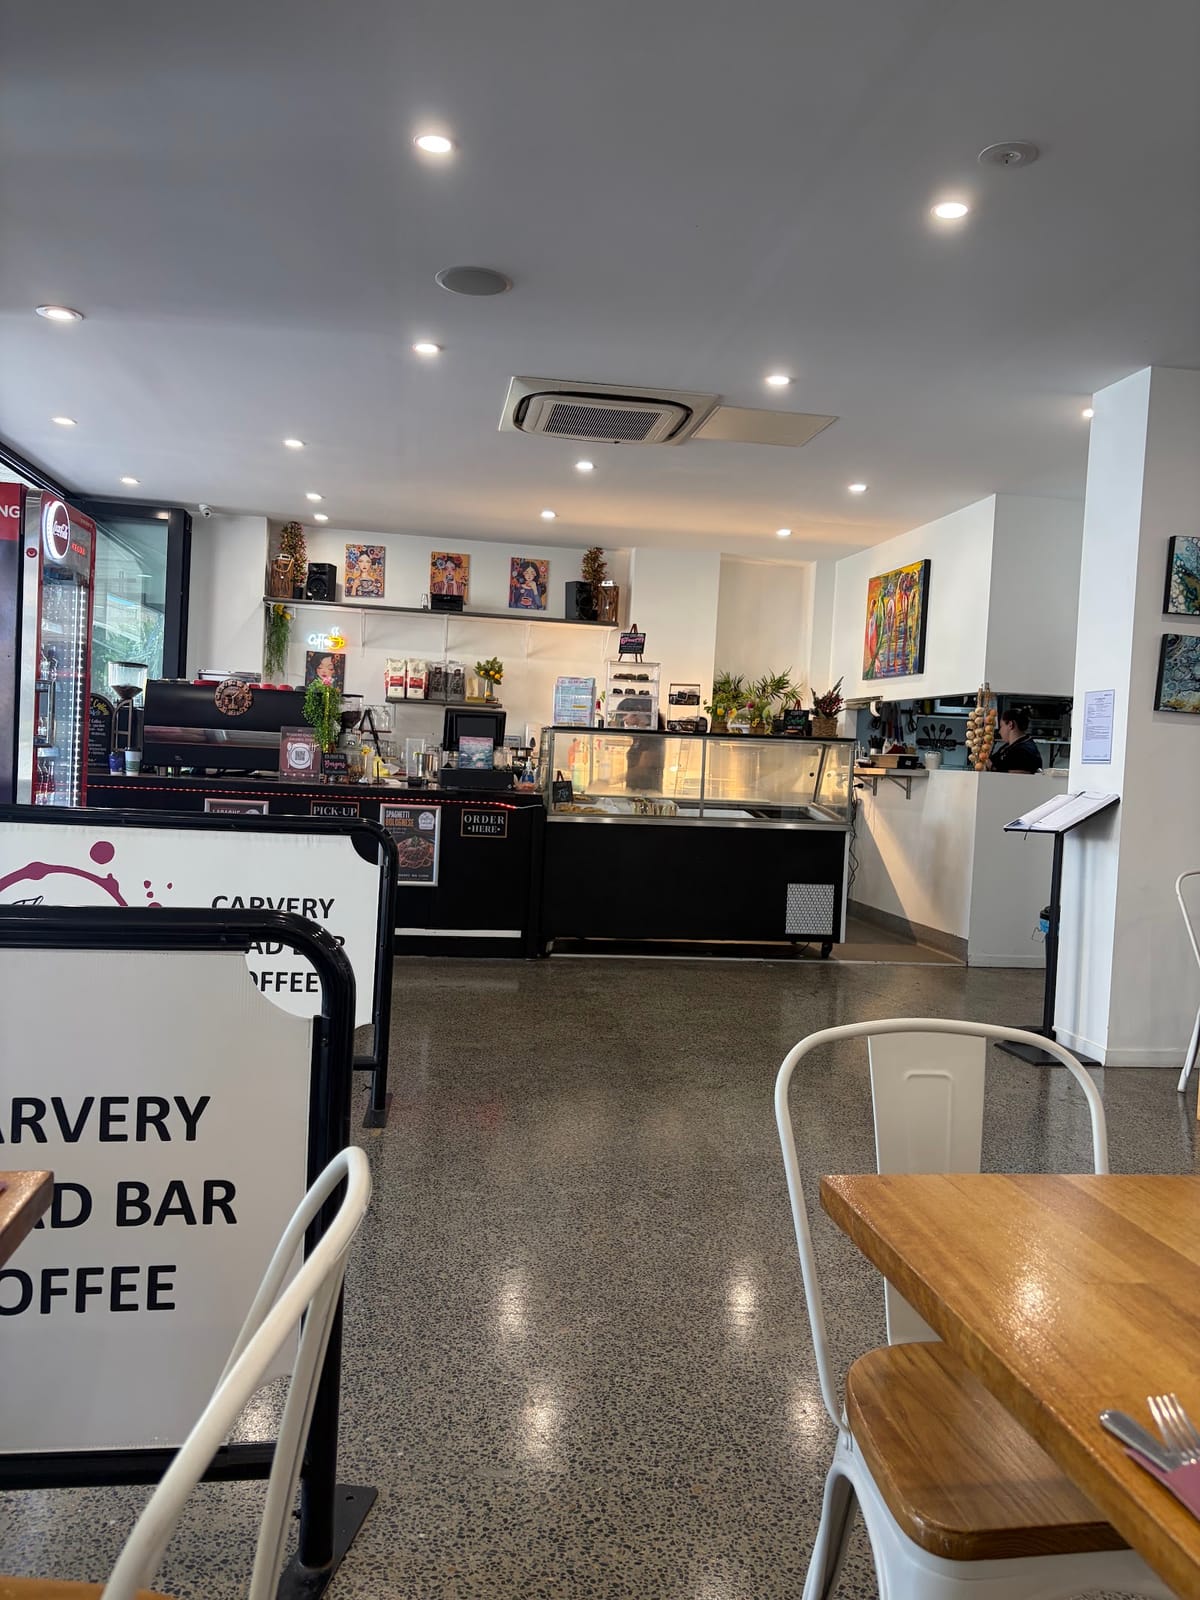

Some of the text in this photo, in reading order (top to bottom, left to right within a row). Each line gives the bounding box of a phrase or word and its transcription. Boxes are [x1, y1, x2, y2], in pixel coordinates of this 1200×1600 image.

[313, 806, 357, 816] PICK-UP
[464, 815, 505, 825] ORDER
[471, 825, 498, 833] HERE
[0, 1096, 211, 1144] RVERY
[116, 1180, 237, 1227] BAR
